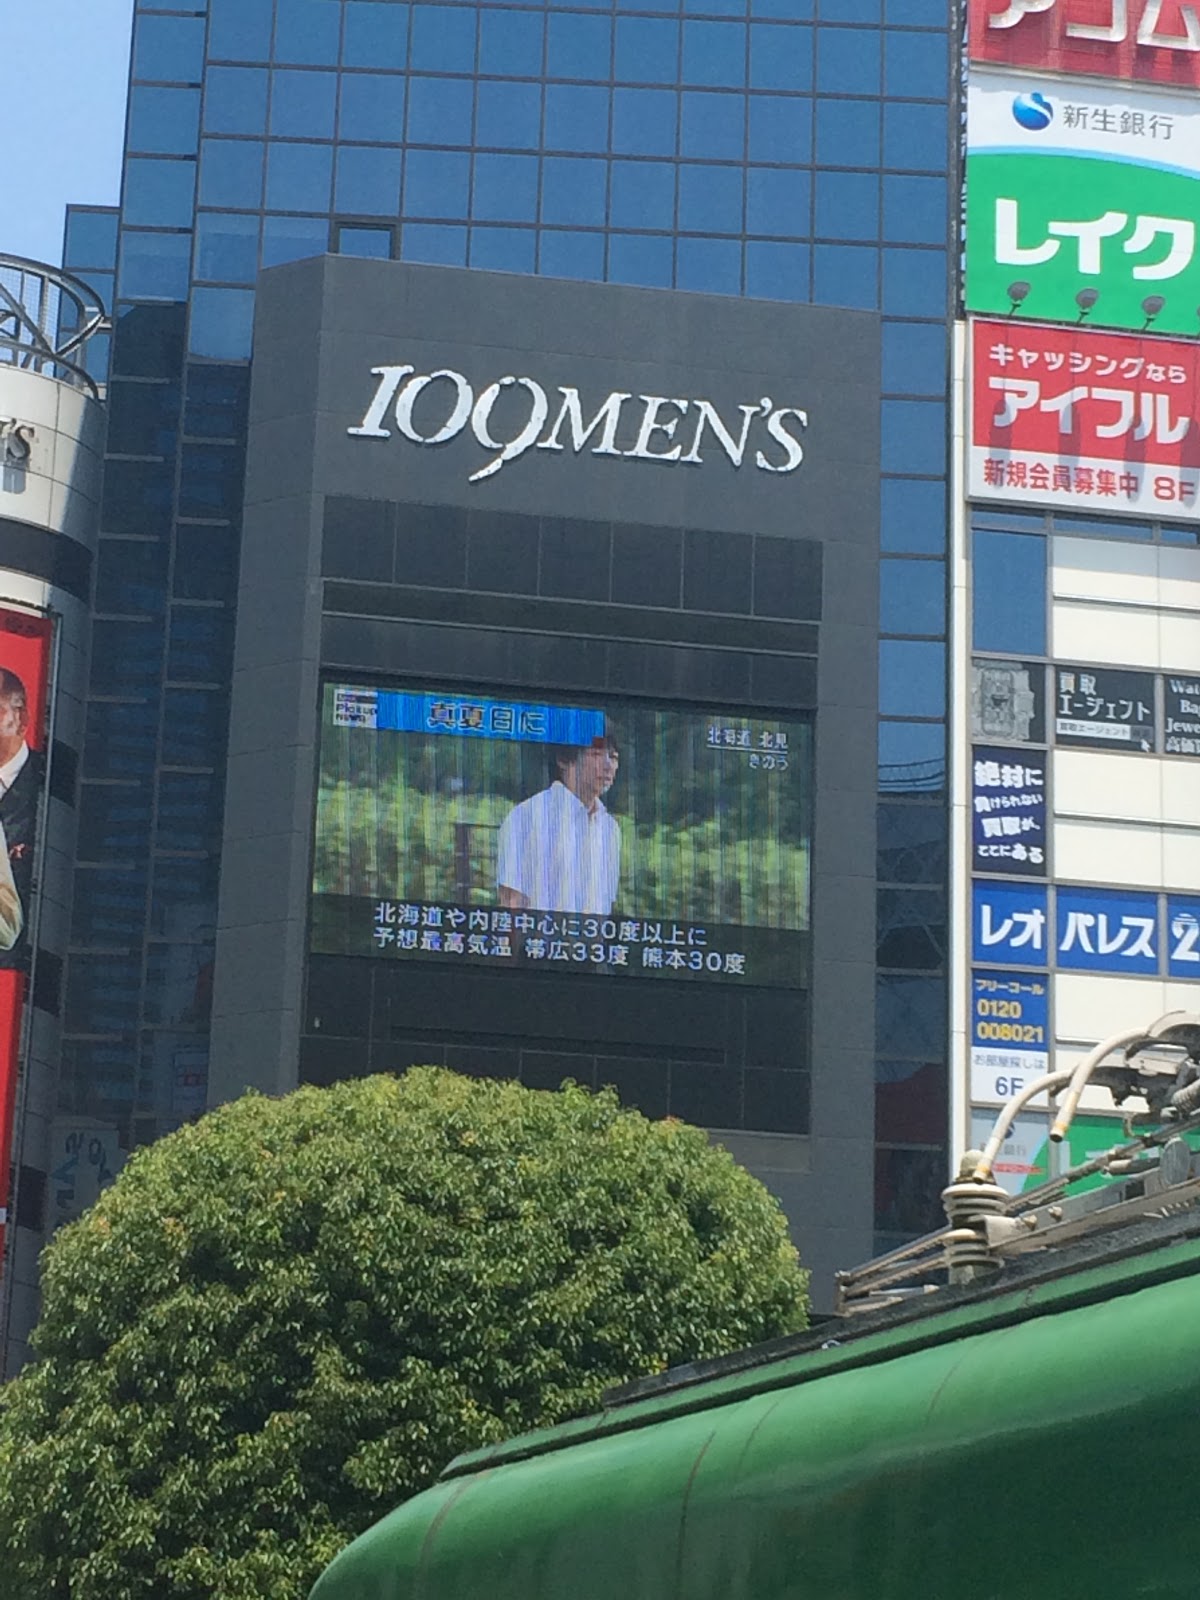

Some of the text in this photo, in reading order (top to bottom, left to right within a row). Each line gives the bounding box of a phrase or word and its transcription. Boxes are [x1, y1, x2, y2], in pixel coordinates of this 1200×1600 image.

[1062, 104, 1174, 140] 新生銀行
[995, 198, 1195, 280] レイク
[989, 343, 1188, 384] キャッシングなら
[988, 376, 1190, 444] アイフル
[984, 458, 1195, 502] 新規会員募集中 8F
[427, 702, 546, 735] 真夏日に
[1059, 694, 1151, 721] エージェント
[974, 760, 1043, 789] 絶対に
[978, 843, 1044, 864] ここにある
[374, 901, 708, 946] 北海道や内陸中心に30度以上に
[373, 926, 746, 975] 予想最高気温 帯広33度 熊本30度
[974, 979, 1045, 995] フリーコール
[977, 999, 1022, 1019] 0120
[977, 1022, 1044, 1043] 008021
[995, 1076, 1024, 1097] 6F
